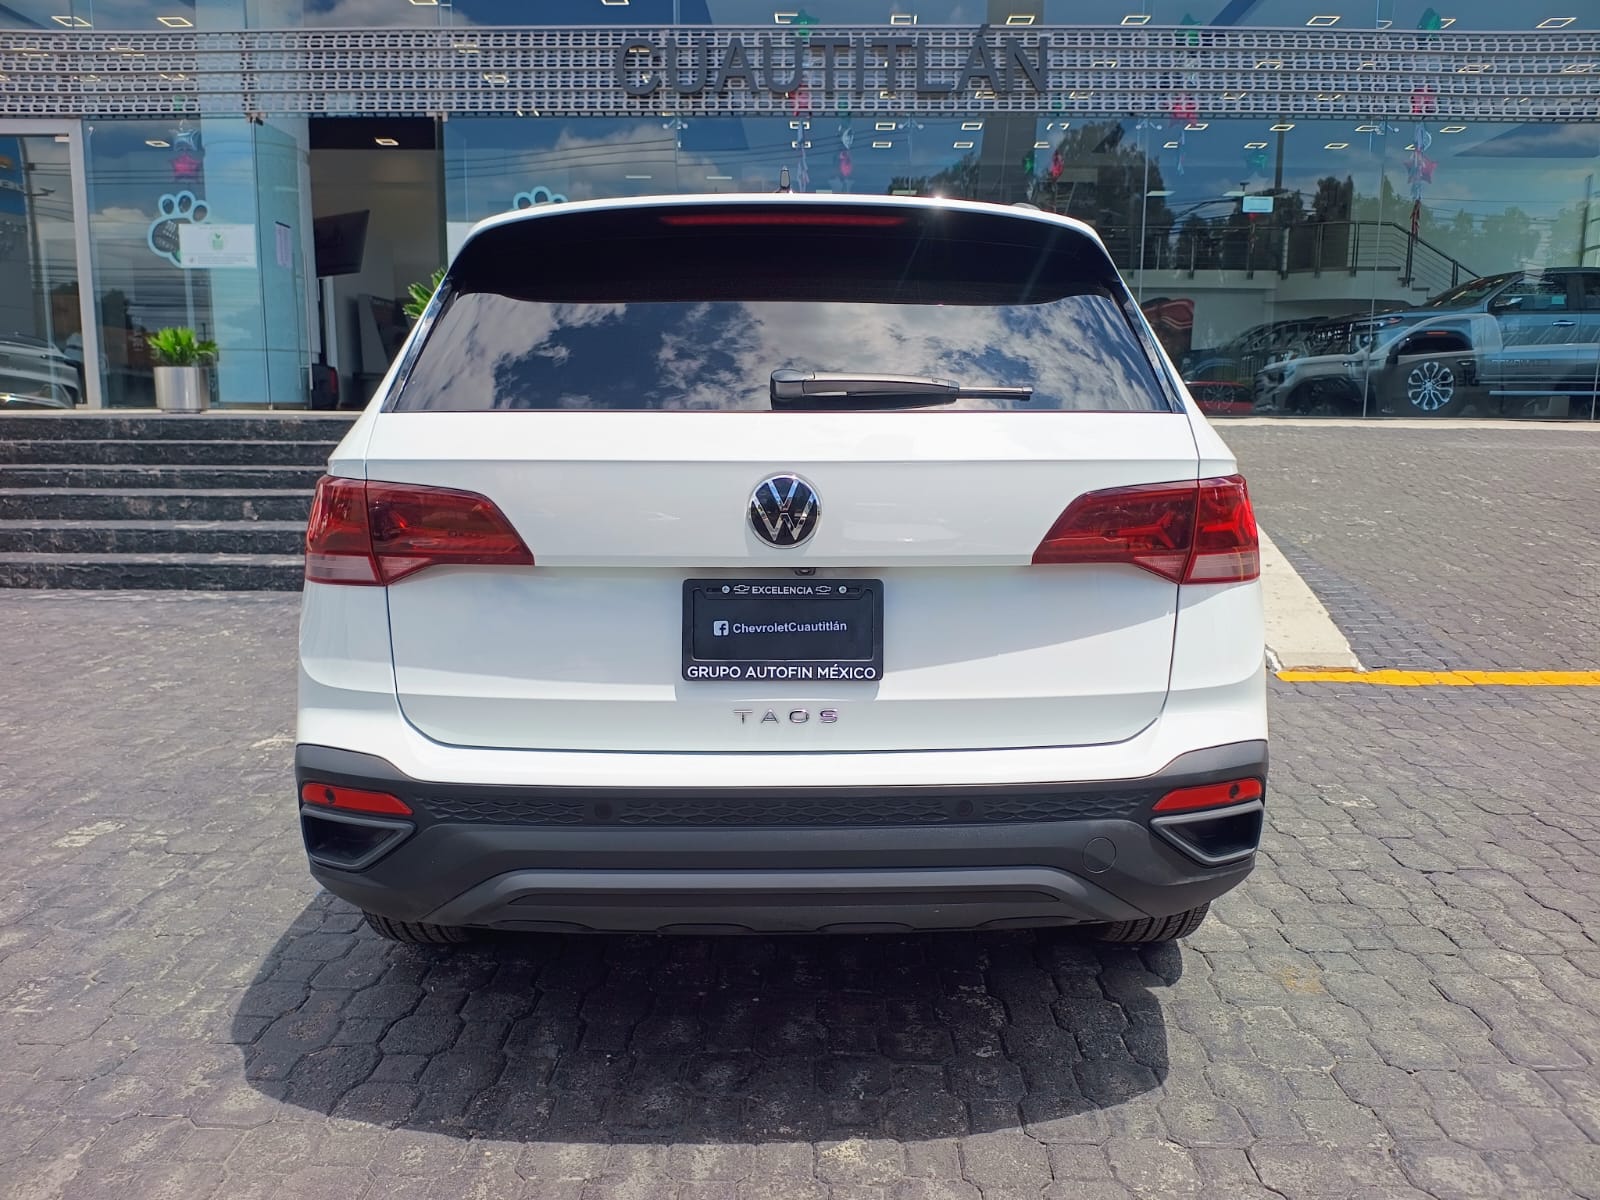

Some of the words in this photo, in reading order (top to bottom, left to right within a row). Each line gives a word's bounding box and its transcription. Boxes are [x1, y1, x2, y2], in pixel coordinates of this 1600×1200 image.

[613, 24, 1049, 96] CUAUTITLÁN
[750, 476, 820, 546] VW
[751, 586, 813, 595] EXCELENCIA
[733, 621, 847, 634] ChevroletCuautitlán
[687, 666, 741, 679] GRUPO
[745, 666, 813, 680] AUTOFIN
[817, 664, 876, 680] MÉXICO
[734, 709, 839, 724] TAOS
